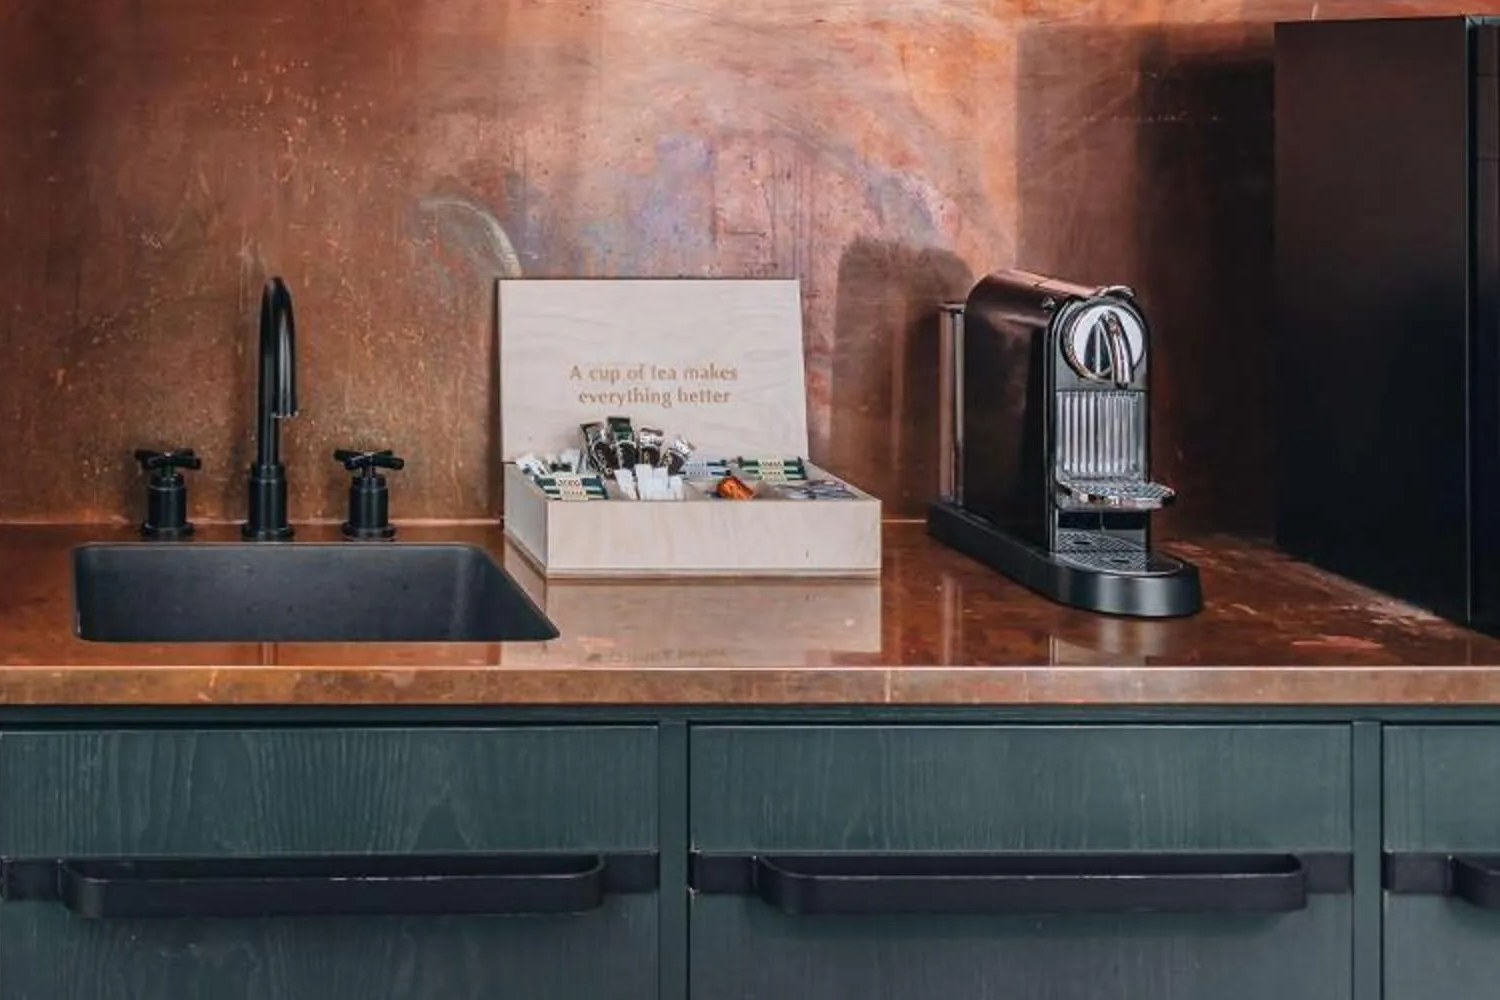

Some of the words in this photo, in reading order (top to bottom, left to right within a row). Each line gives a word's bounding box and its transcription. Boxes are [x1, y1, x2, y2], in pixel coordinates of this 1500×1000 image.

[569, 365, 582, 380] A
[589, 367, 621, 385] cup
[626, 364, 645, 381] of
[651, 365, 677, 381] tea
[683, 363, 738, 381] makes
[578, 387, 672, 409] everything
[678, 387, 732, 404] better
